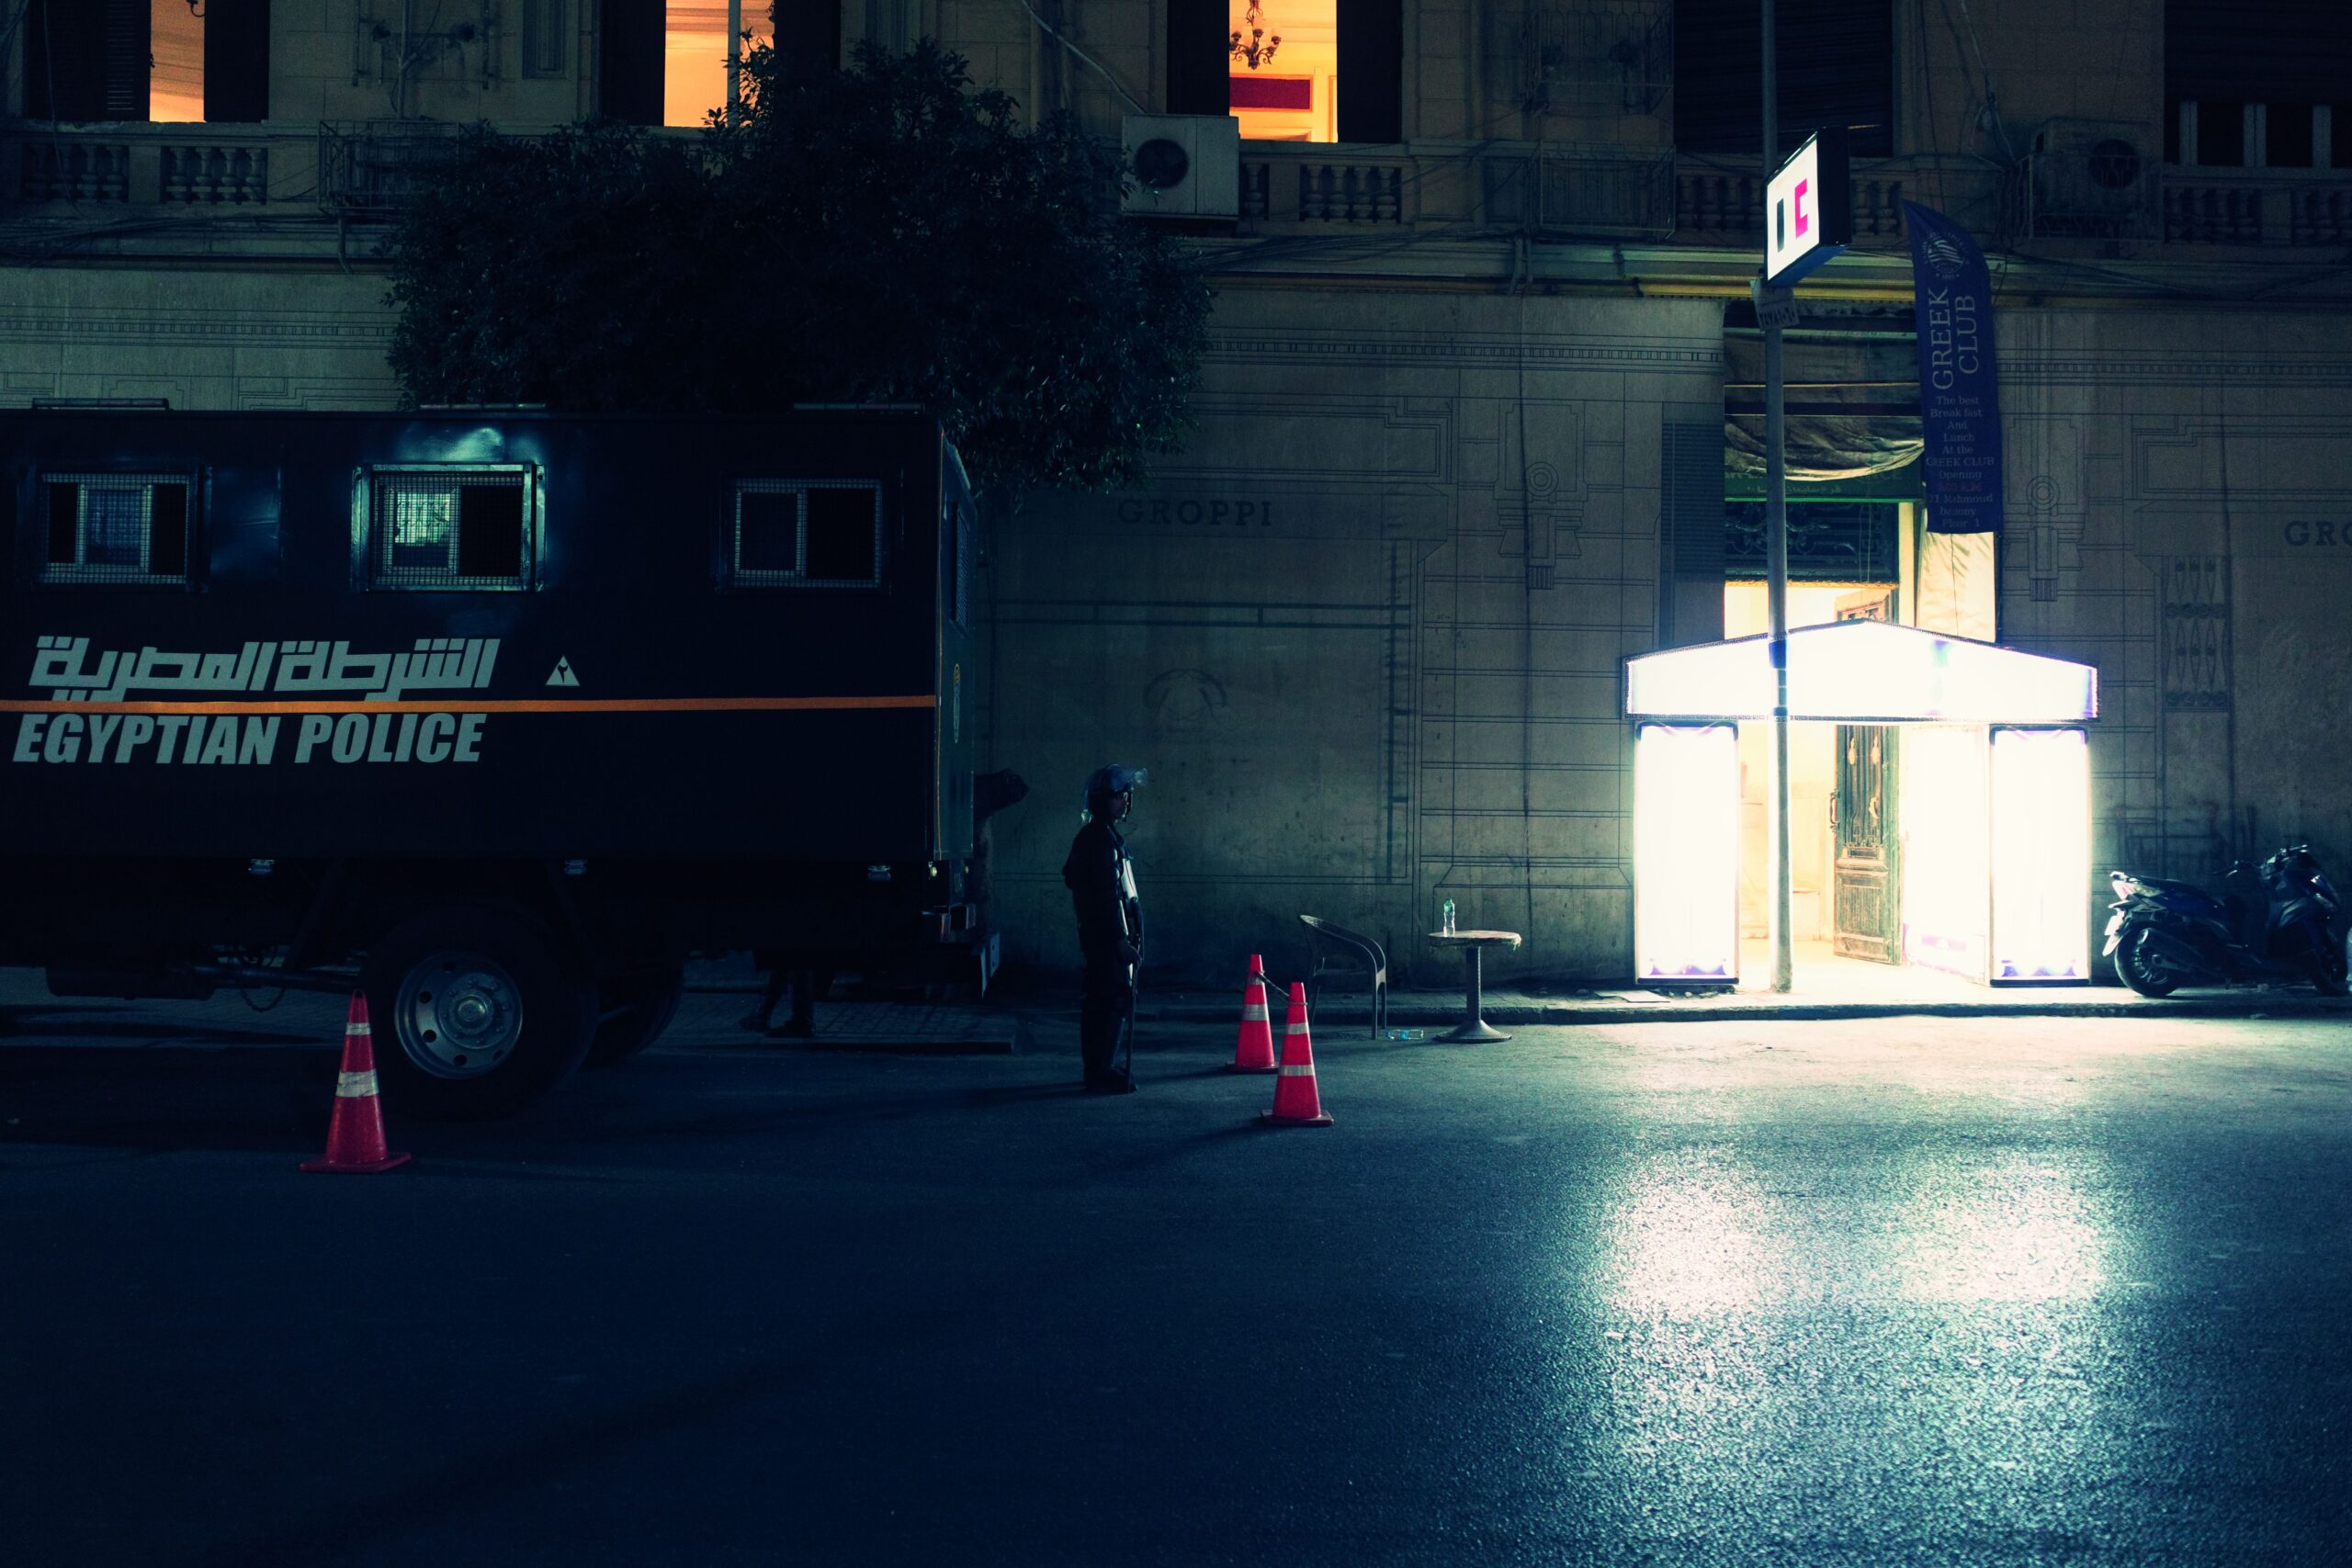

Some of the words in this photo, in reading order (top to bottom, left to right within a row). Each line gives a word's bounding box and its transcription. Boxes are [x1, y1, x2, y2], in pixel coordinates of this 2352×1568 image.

[1928, 287, 1954, 389] GREEK
[1955, 295, 1979, 375] CLUB
[1936, 396, 1955, 405] The
[1958, 395, 1979, 405] best
[1930, 409, 1962, 418] Break
[1947, 421, 1968, 430] And
[1943, 433, 1975, 443] Lunch
[1942, 446, 1954, 455] At
[1957, 445, 1974, 455] the
[1926, 457, 1962, 467] GREEK
[1963, 457, 1995, 467] CLUB
[1939, 469, 1983, 480] Opening
[1117, 498, 1272, 527] GROPPI
[28, 636, 277, 702] المصرية
[274, 637, 501, 702] الشرطة
[12, 713, 281, 765] EGYPTIAN
[294, 712, 487, 764] POLICE
